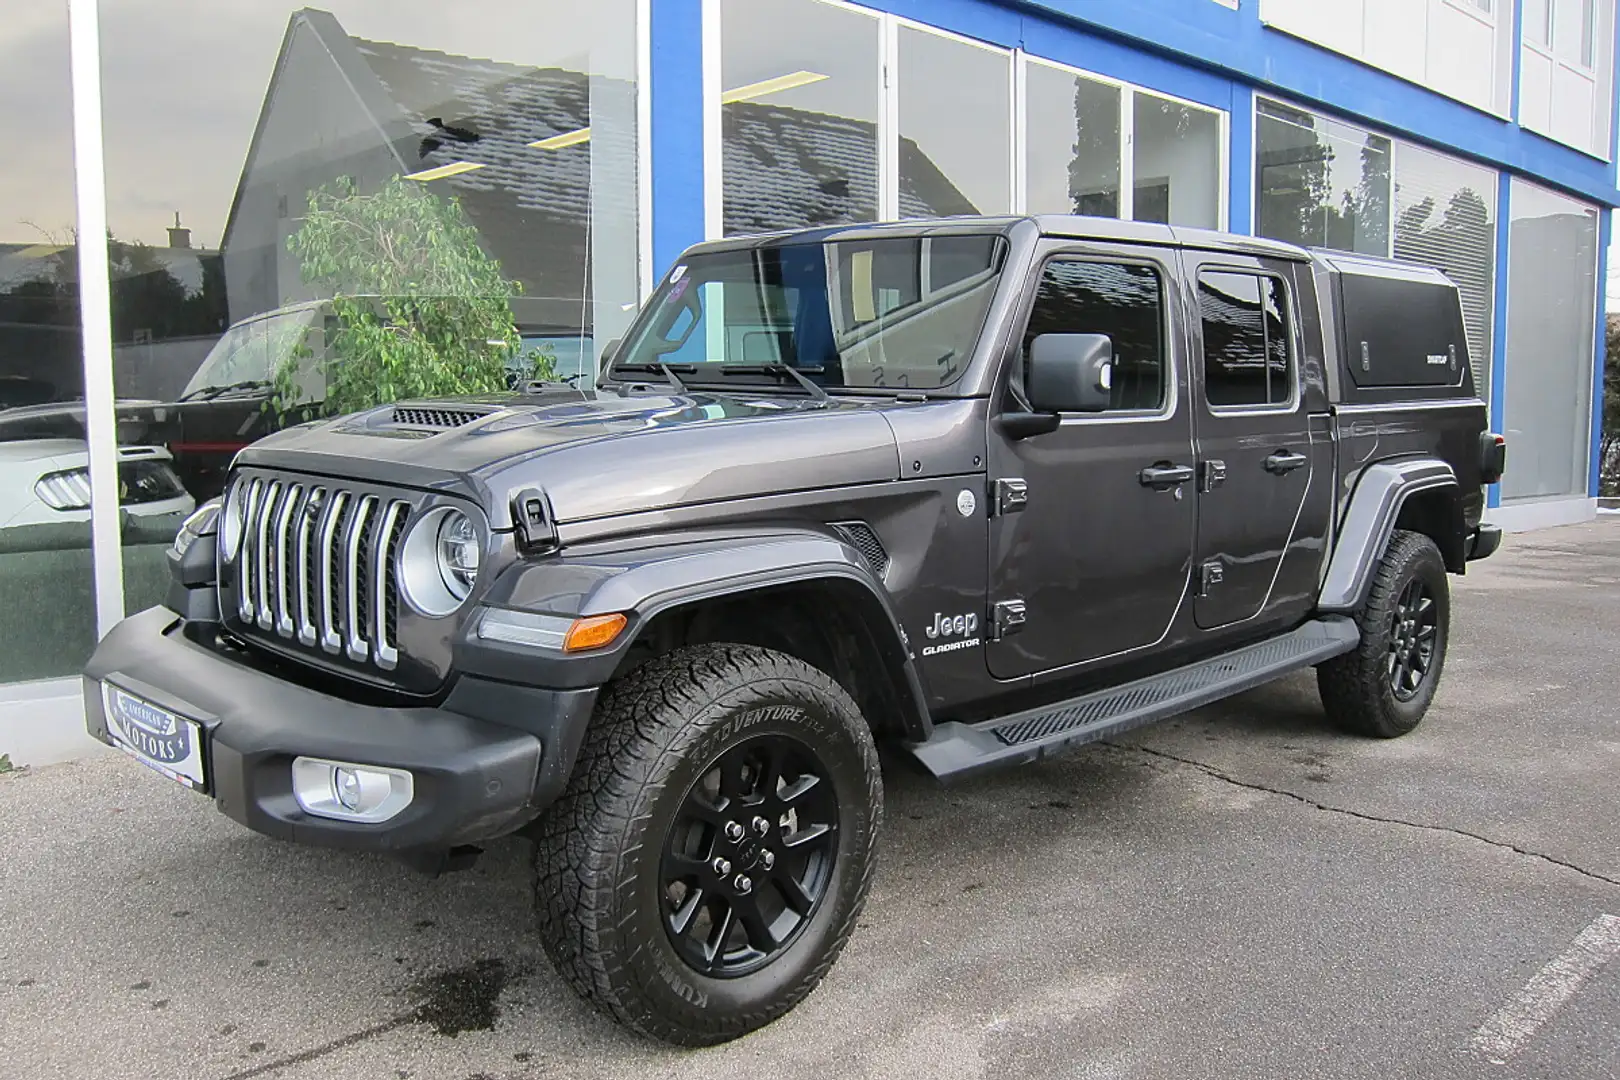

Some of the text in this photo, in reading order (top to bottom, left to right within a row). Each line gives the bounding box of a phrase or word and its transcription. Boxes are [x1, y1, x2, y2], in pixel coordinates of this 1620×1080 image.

[925, 612, 978, 639] Jeep
[922, 638, 980, 656] GLADIATOR
[733, 704, 804, 733] VENTURE
[122, 717, 176, 759] MOTORS
